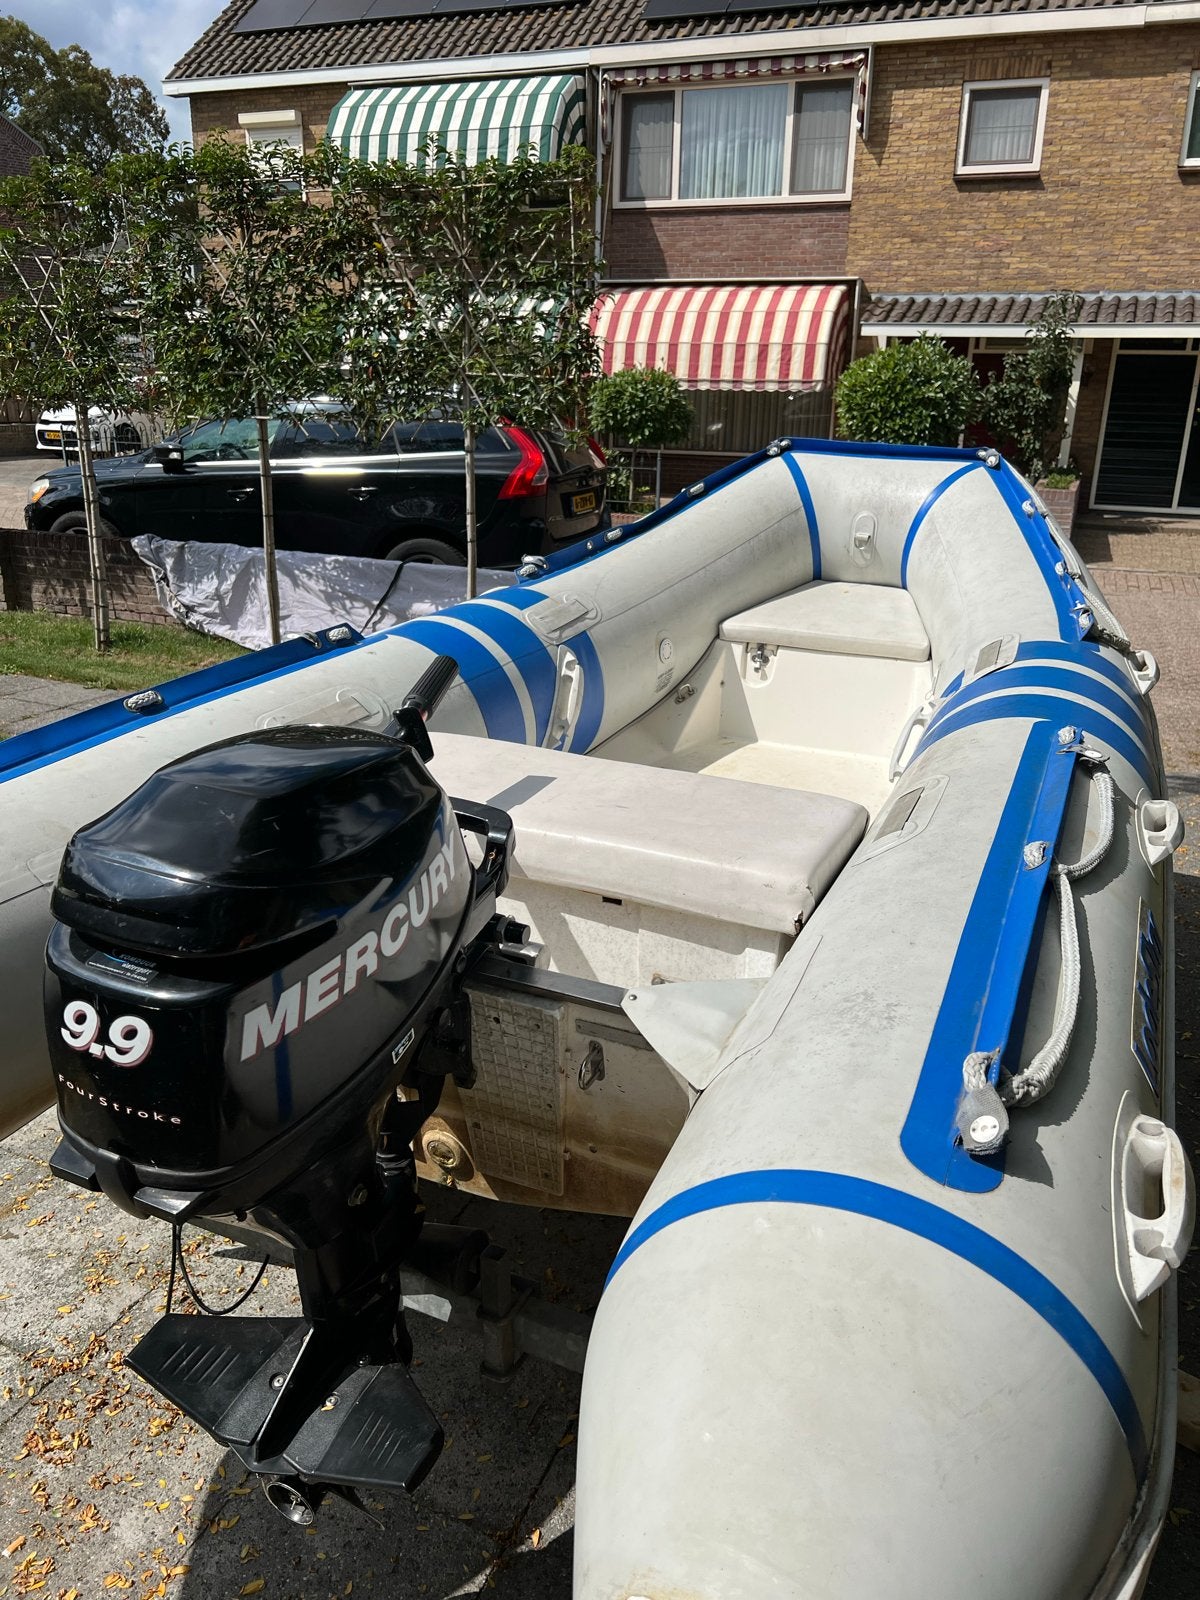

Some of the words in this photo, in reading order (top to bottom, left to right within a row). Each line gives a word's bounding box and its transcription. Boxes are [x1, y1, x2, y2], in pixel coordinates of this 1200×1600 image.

[240, 829, 456, 1063] MERCURY
[61, 1001, 153, 1066] 9.9
[58, 1073, 181, 1125] FourStroke
